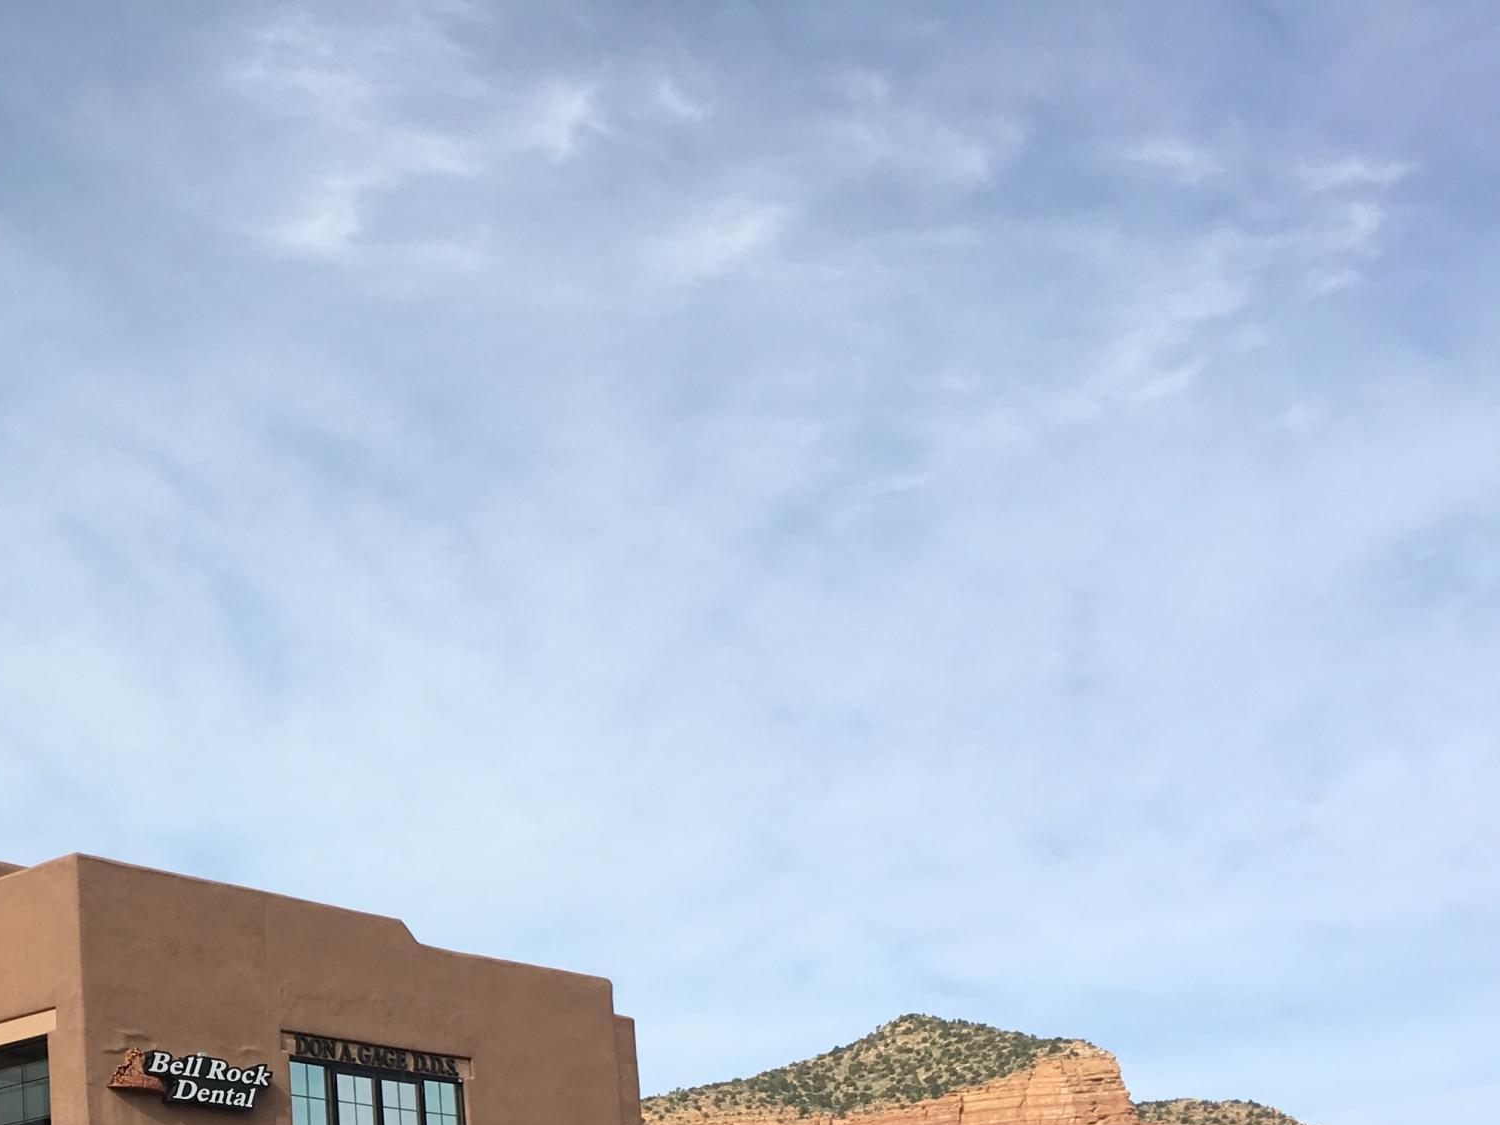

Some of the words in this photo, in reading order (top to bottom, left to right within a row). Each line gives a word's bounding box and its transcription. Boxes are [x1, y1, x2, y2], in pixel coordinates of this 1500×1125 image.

[149, 1052, 203, 1078] Bell
[206, 1059, 271, 1087] Rock
[295, 1037, 336, 1059] DON
[357, 1046, 408, 1070] GAGE
[173, 1079, 257, 1108] Dental
